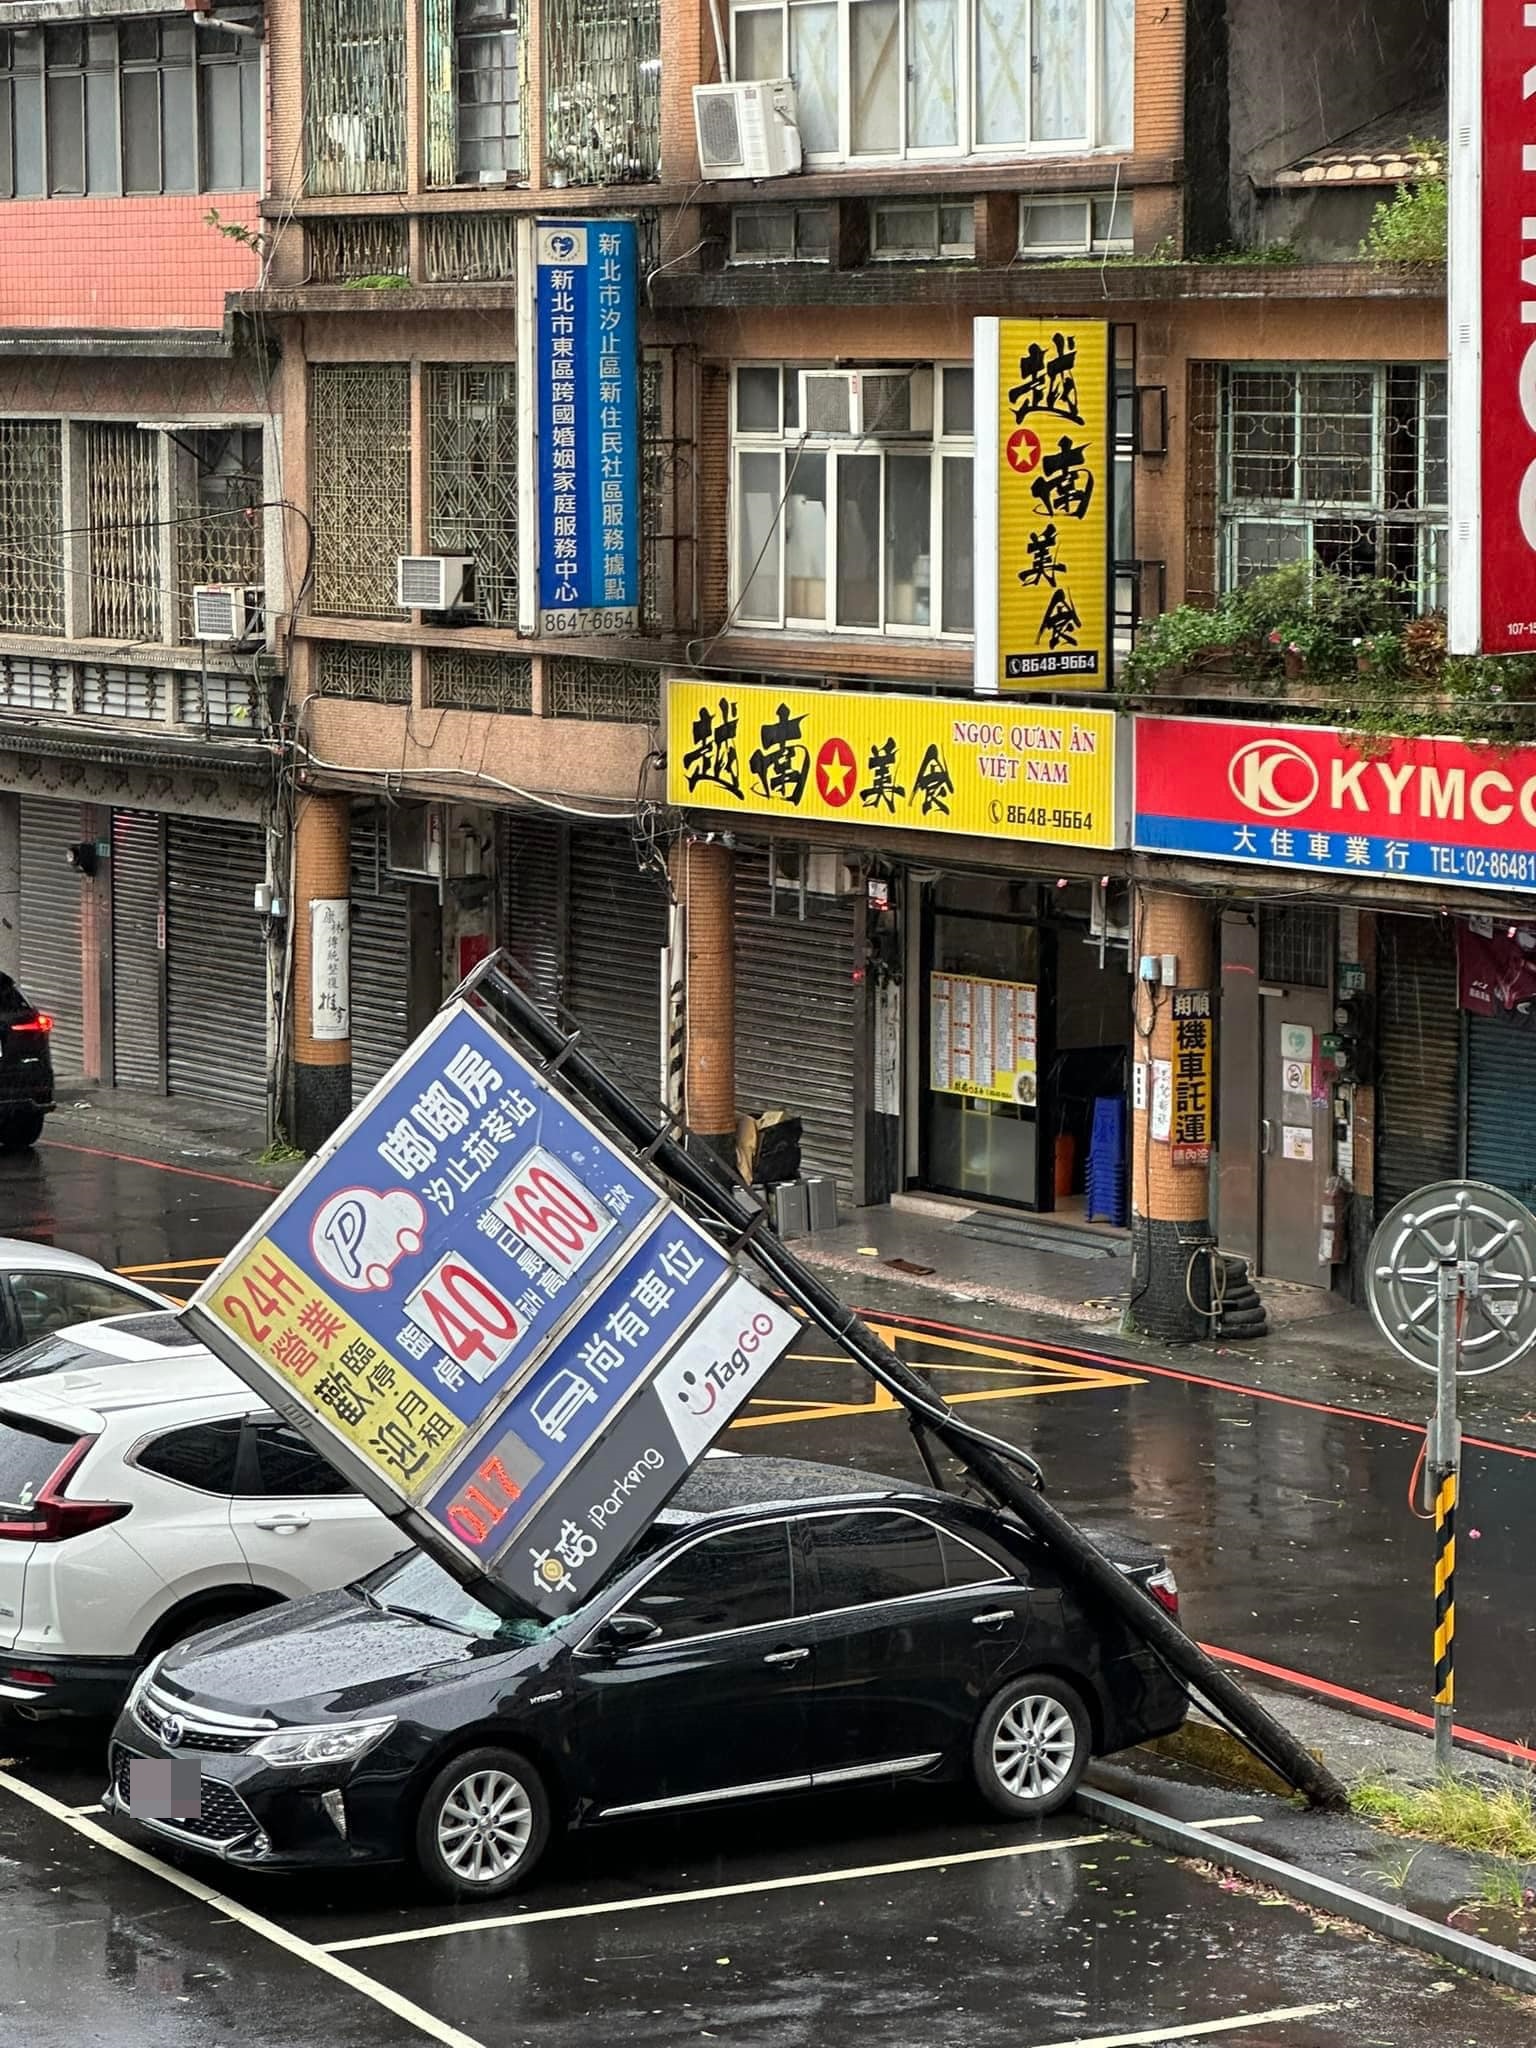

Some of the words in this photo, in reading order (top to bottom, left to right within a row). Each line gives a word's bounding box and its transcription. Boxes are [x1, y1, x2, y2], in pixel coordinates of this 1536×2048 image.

[550, 269, 578, 602] 新北市東區跨國婚姻家庭服務中心
[598, 232, 626, 601] 新北市汐止區新住民社區服務據點
[545, 610, 634, 633] 8647-6654
[1020, 651, 1096, 672] 8648-9664
[954, 722, 1003, 749] NGỌC
[978, 753, 1019, 784] VIỆT
[1027, 761, 1069, 783] NAM
[1007, 805, 1093, 830] 8648-9664
[1232, 823, 1410, 871] 大佳車業行
[377, 1043, 504, 1181] 嘟嘟房
[1175, 1020, 1207, 1144] 機車託運
[421, 1088, 537, 1217] 汐止茄苳站
[476, 1209, 568, 1299] 當日最高
[503, 1167, 599, 1265] 160
[223, 1253, 305, 1343] 24H
[269, 1298, 347, 1378] 營業
[421, 1264, 519, 1362] 40
[577, 1239, 705, 1384] 尚有車位
[395, 1321, 465, 1393] 臨停
[312, 1367, 431, 1481] 歡迎
